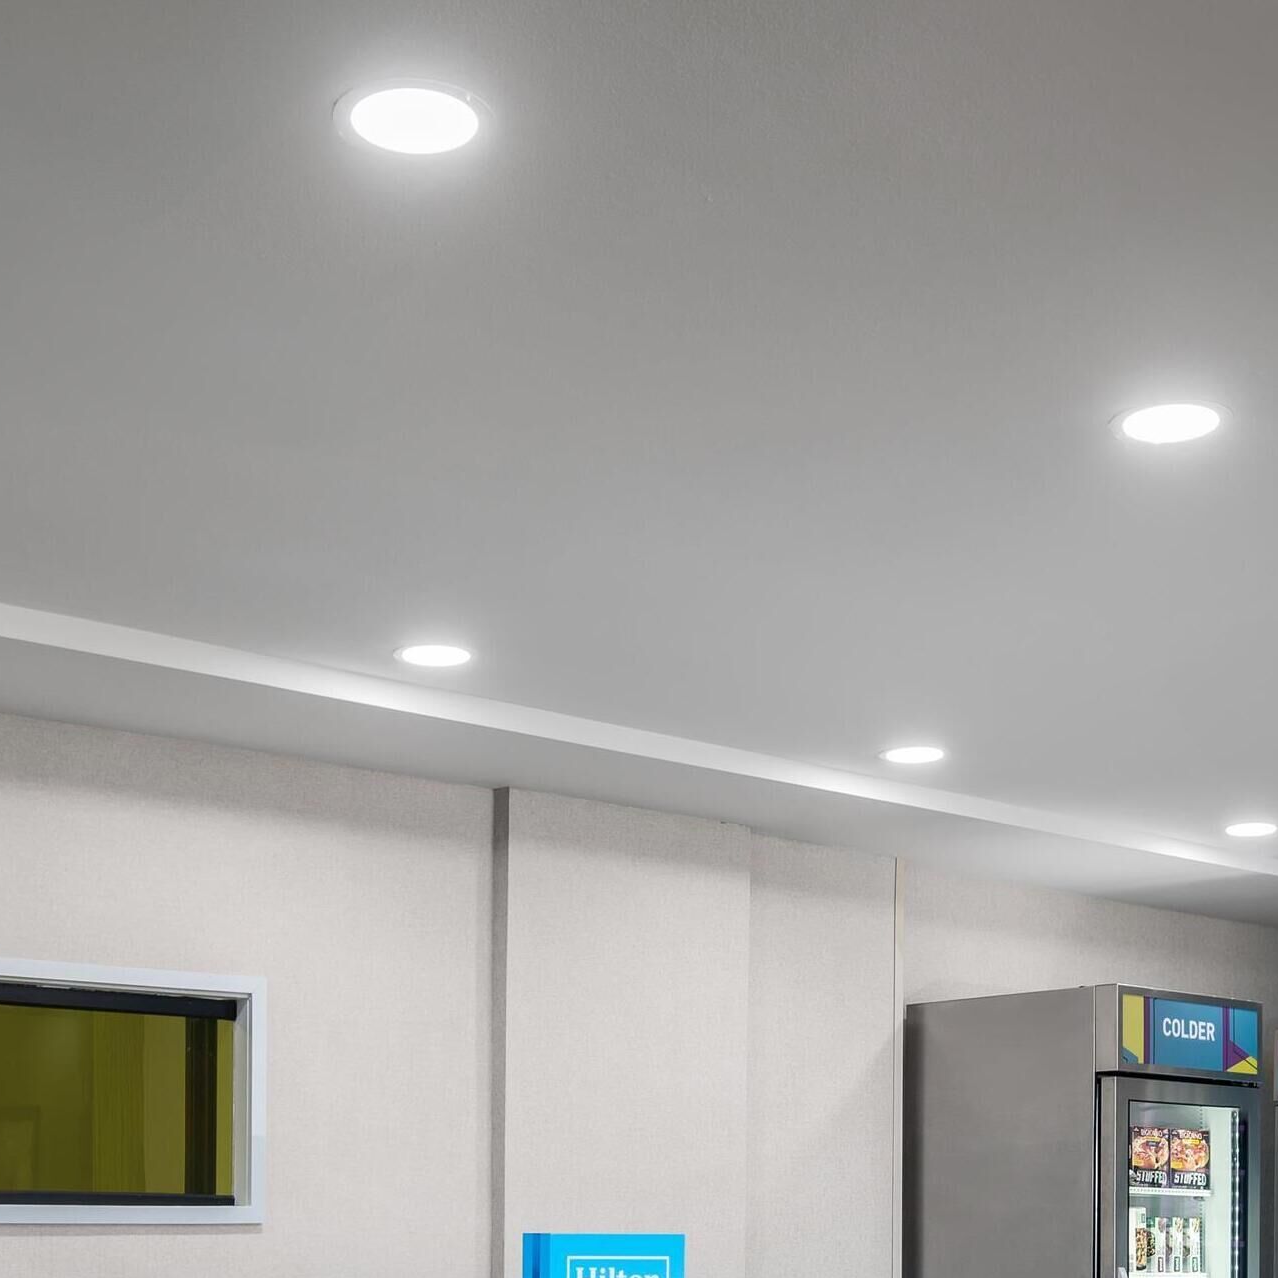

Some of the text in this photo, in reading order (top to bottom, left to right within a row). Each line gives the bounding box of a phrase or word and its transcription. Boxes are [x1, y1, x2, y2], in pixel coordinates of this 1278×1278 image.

[1162, 1017, 1216, 1042] COLDER
[1136, 1170, 1167, 1186] STUFFED
[1174, 1172, 1207, 1186] STUFFED
